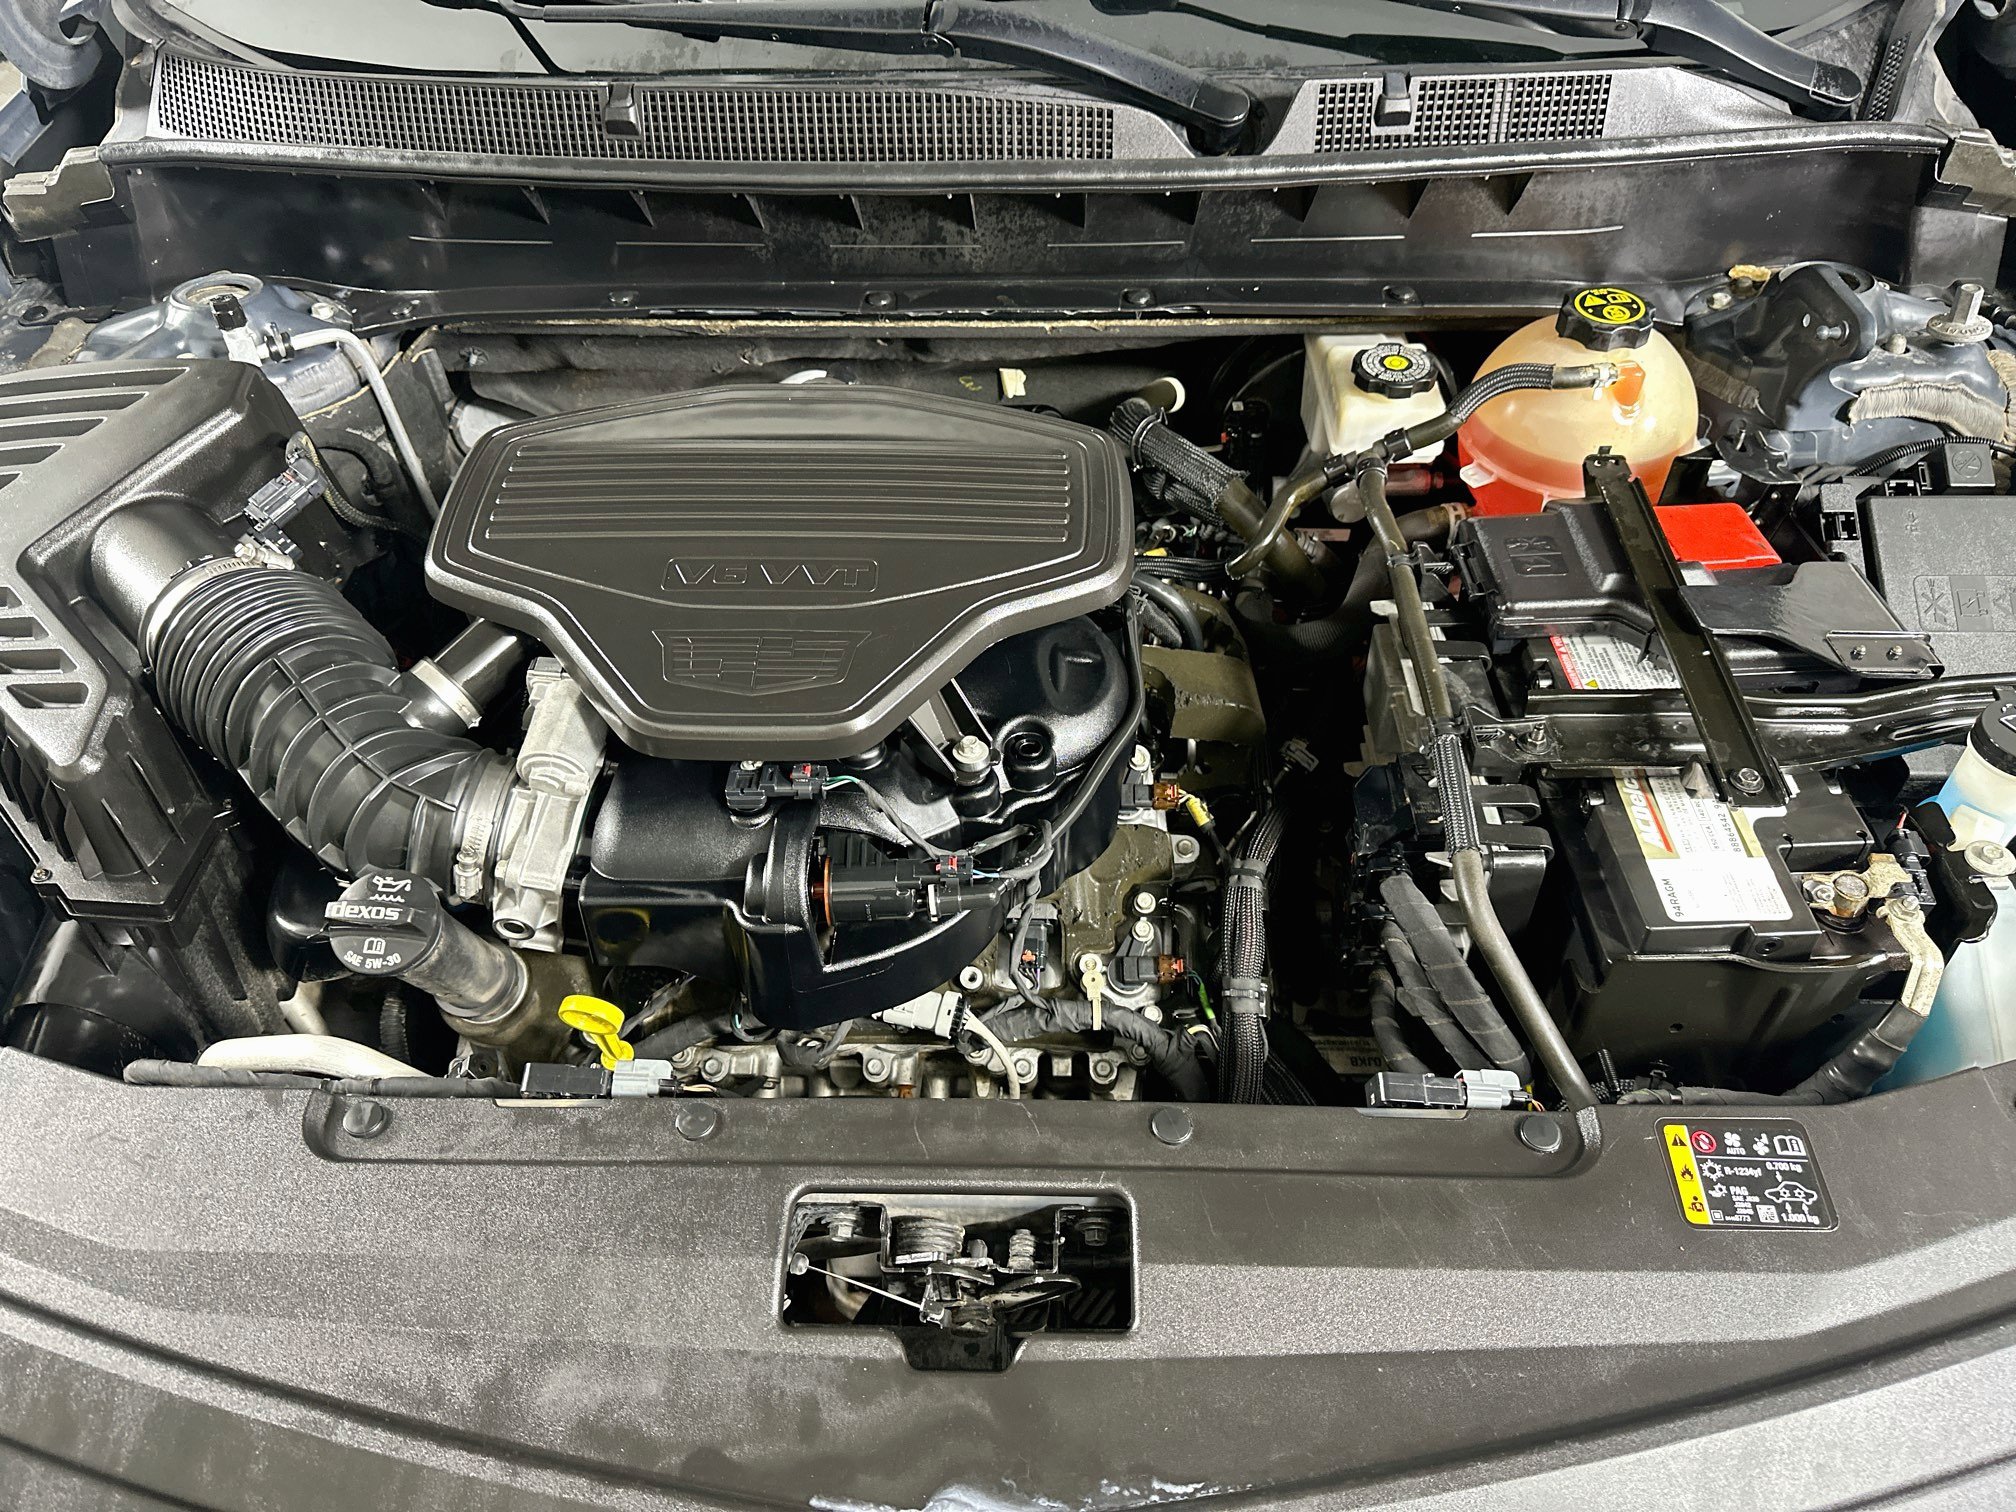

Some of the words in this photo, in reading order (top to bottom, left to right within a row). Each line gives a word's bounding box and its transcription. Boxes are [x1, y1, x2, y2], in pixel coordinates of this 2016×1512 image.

[675, 564, 748, 585] V6
[760, 564, 870, 586] VVT
[1717, 813, 1742, 853] 88864542
[1660, 878, 1684, 917] 94RAGM
[330, 901, 403, 921] dexos
[343, 950, 364, 967] SAE
[364, 952, 402, 970] 5W-30
[1726, 1147, 1746, 1155] AUTO
[1724, 1166, 1762, 1178] R-1234yf
[1790, 1163, 1803, 1173] kg
[1729, 1186, 1749, 1196] PAG
[1806, 1214, 1820, 1225] kg
